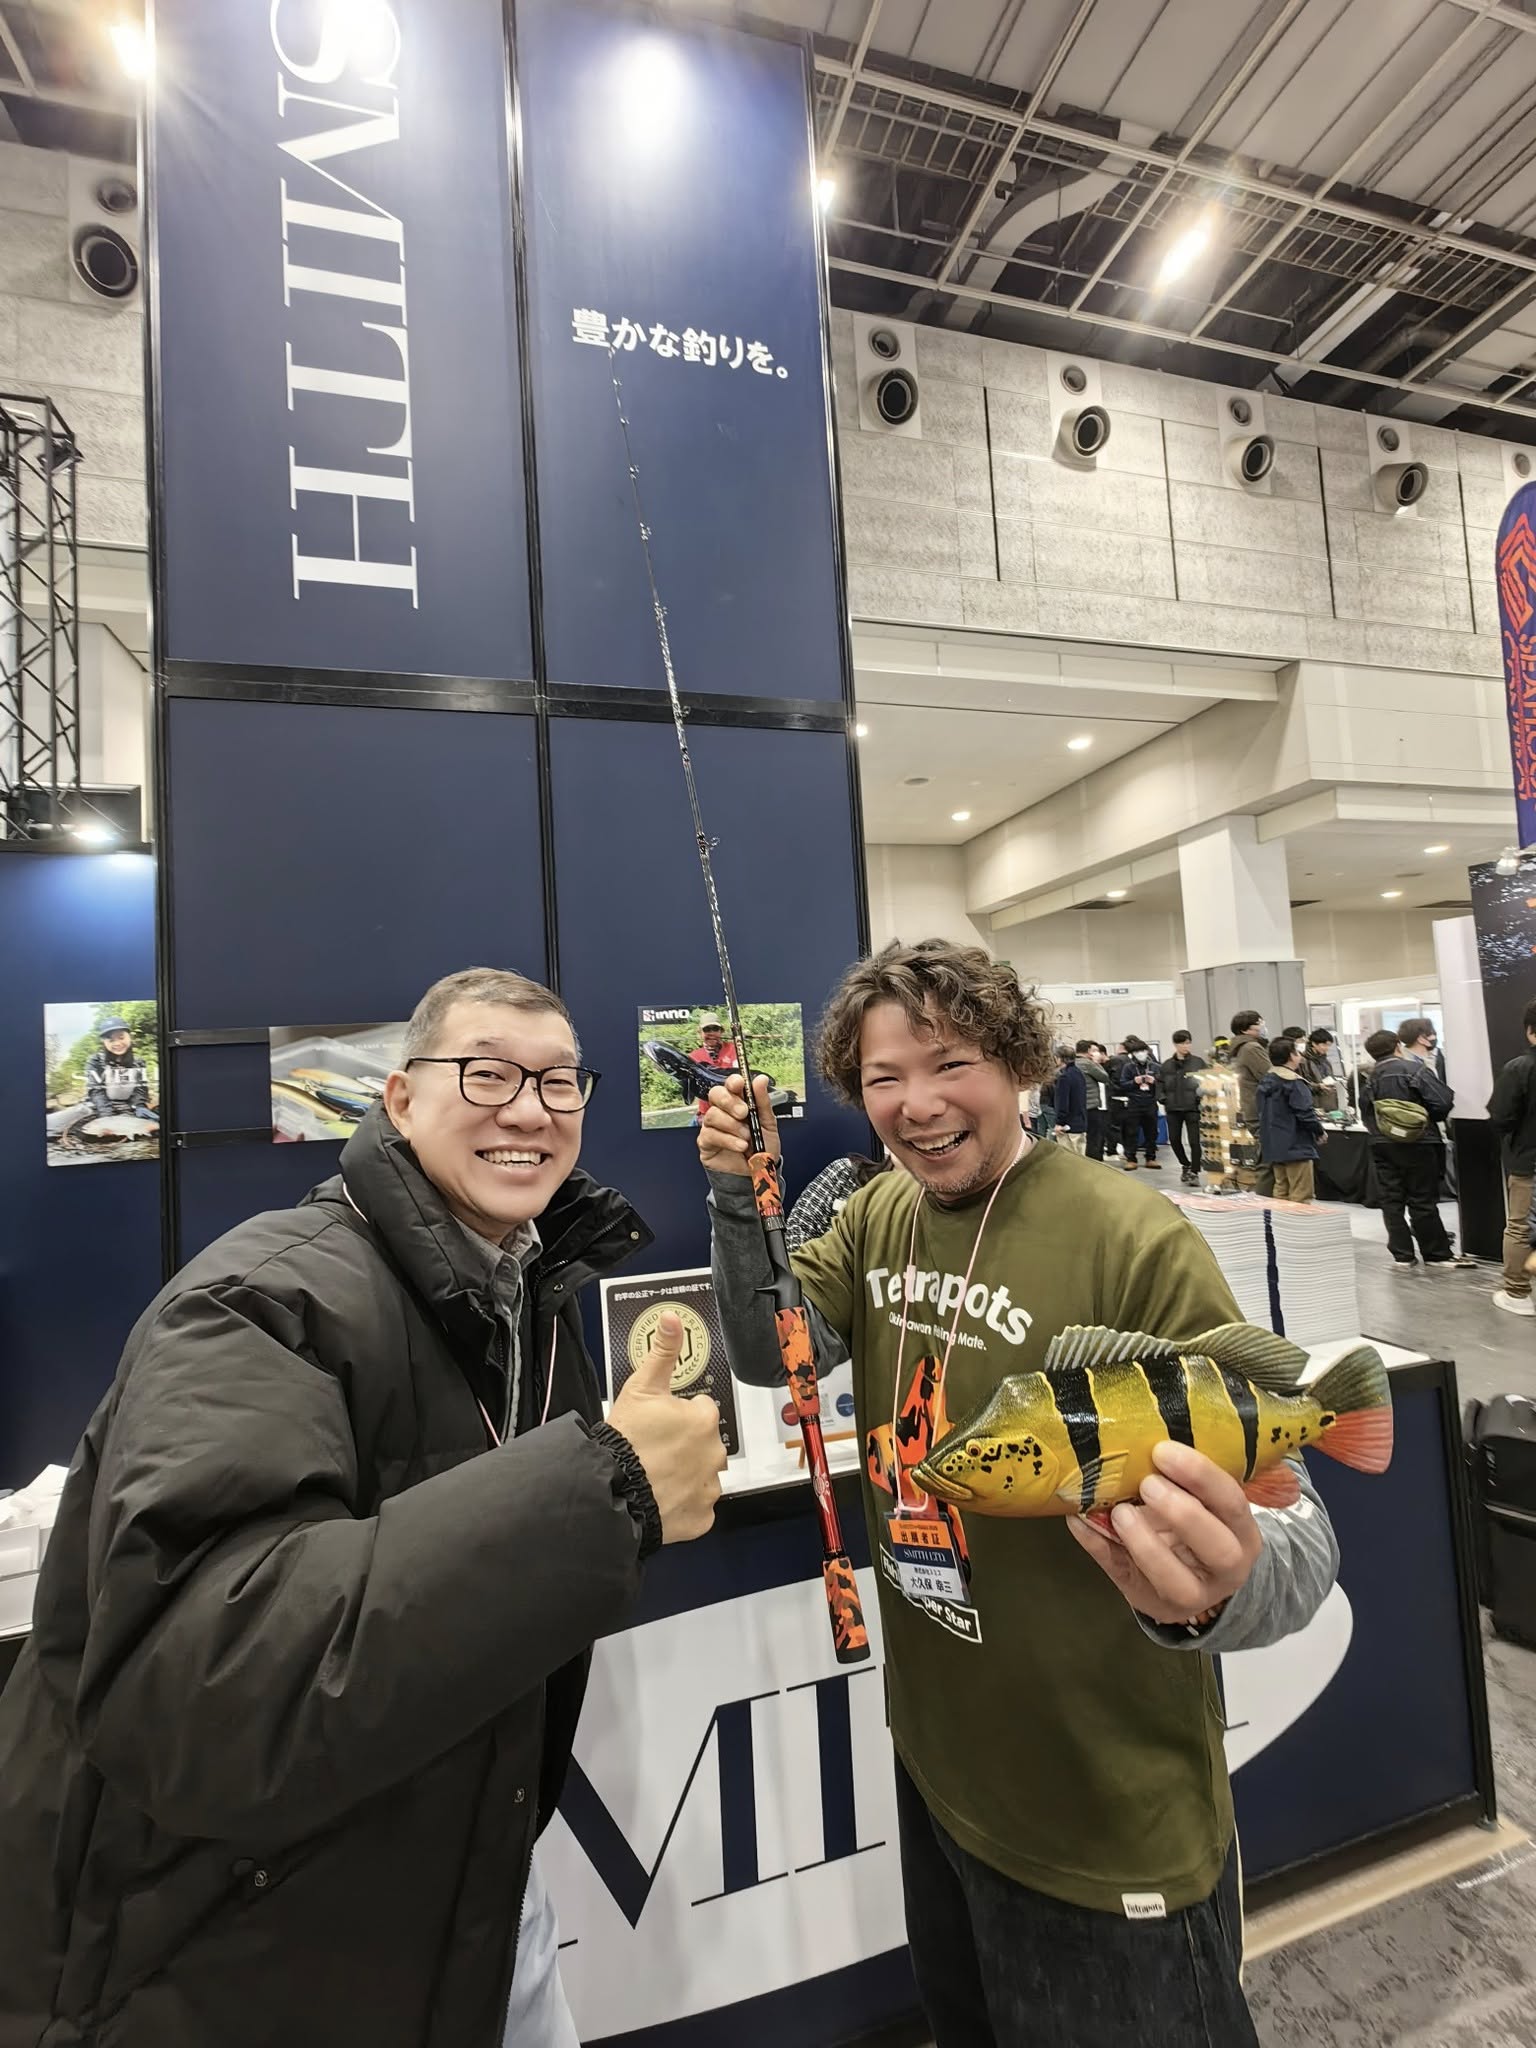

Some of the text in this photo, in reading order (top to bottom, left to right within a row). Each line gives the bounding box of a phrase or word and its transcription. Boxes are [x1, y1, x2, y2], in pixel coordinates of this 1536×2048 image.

[270, 0, 418, 609] SMITH
[572, 308, 789, 378] 豊かな釣りを。
[866, 1265, 1034, 1345] Tetrapots
[922, 1596, 943, 1616] per
[944, 1606, 972, 1632] Star
